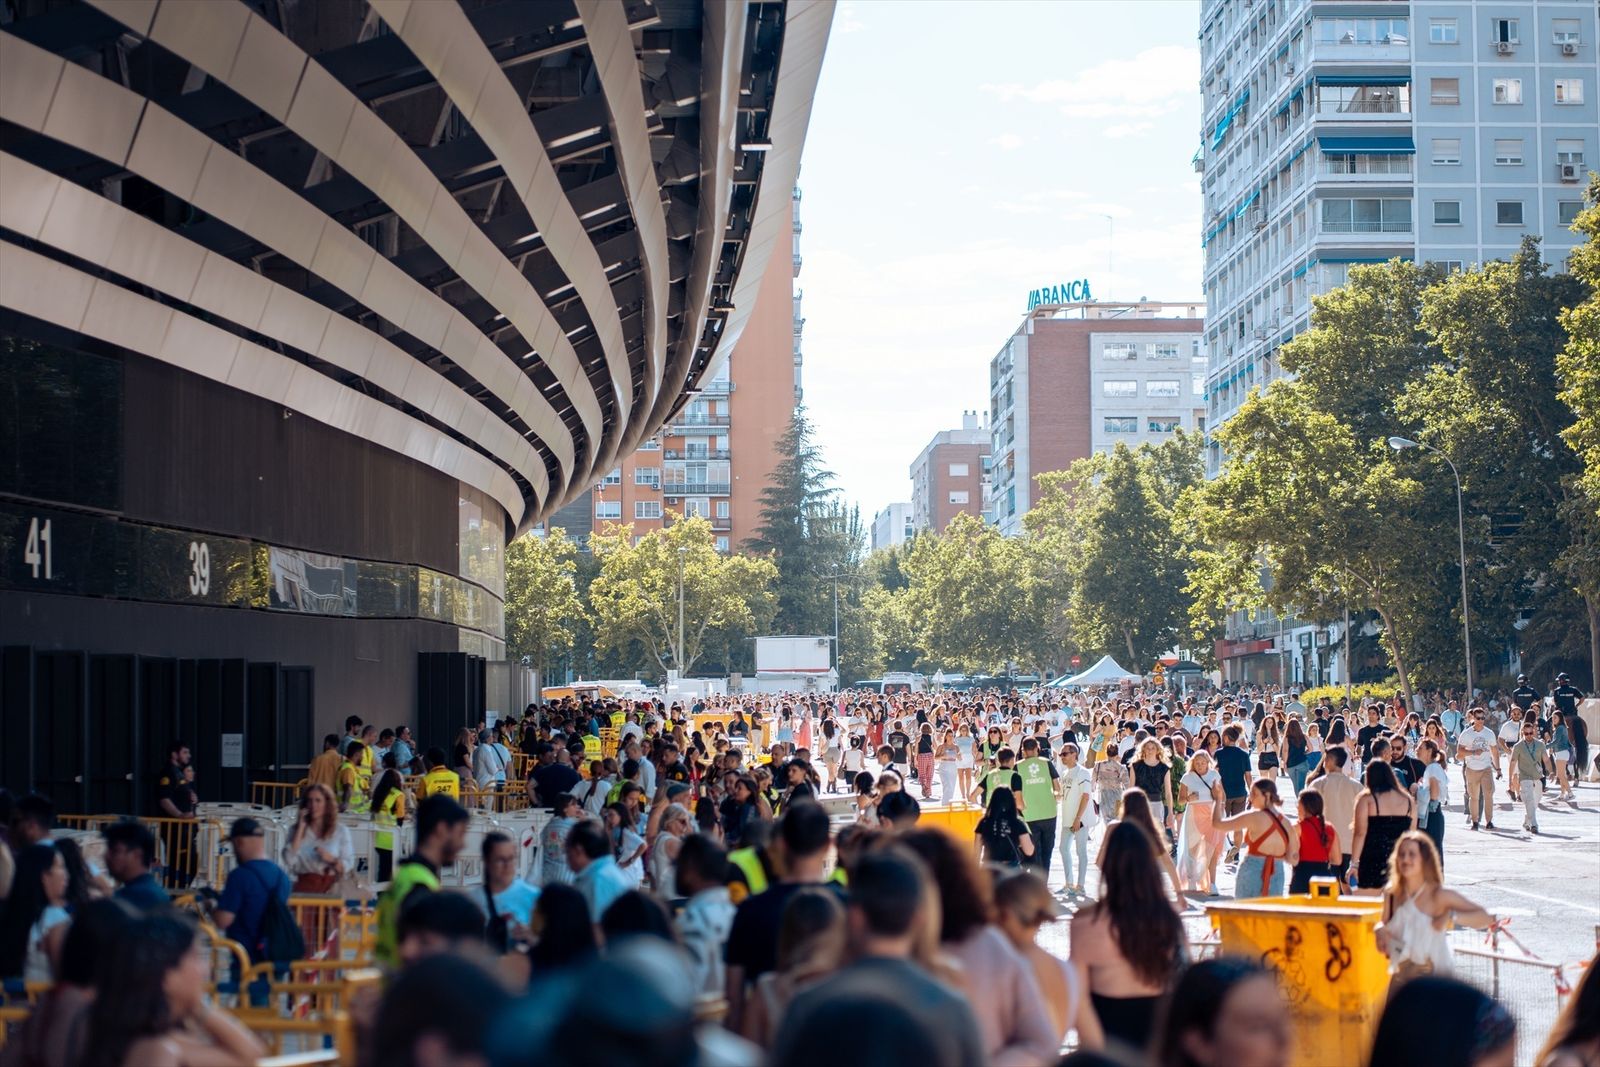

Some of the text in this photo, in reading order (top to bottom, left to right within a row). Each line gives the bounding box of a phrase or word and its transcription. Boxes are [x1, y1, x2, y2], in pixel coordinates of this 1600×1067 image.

[25, 517, 51, 579] 41
[189, 541, 209, 595] 39
[437, 785, 451, 793] 247
